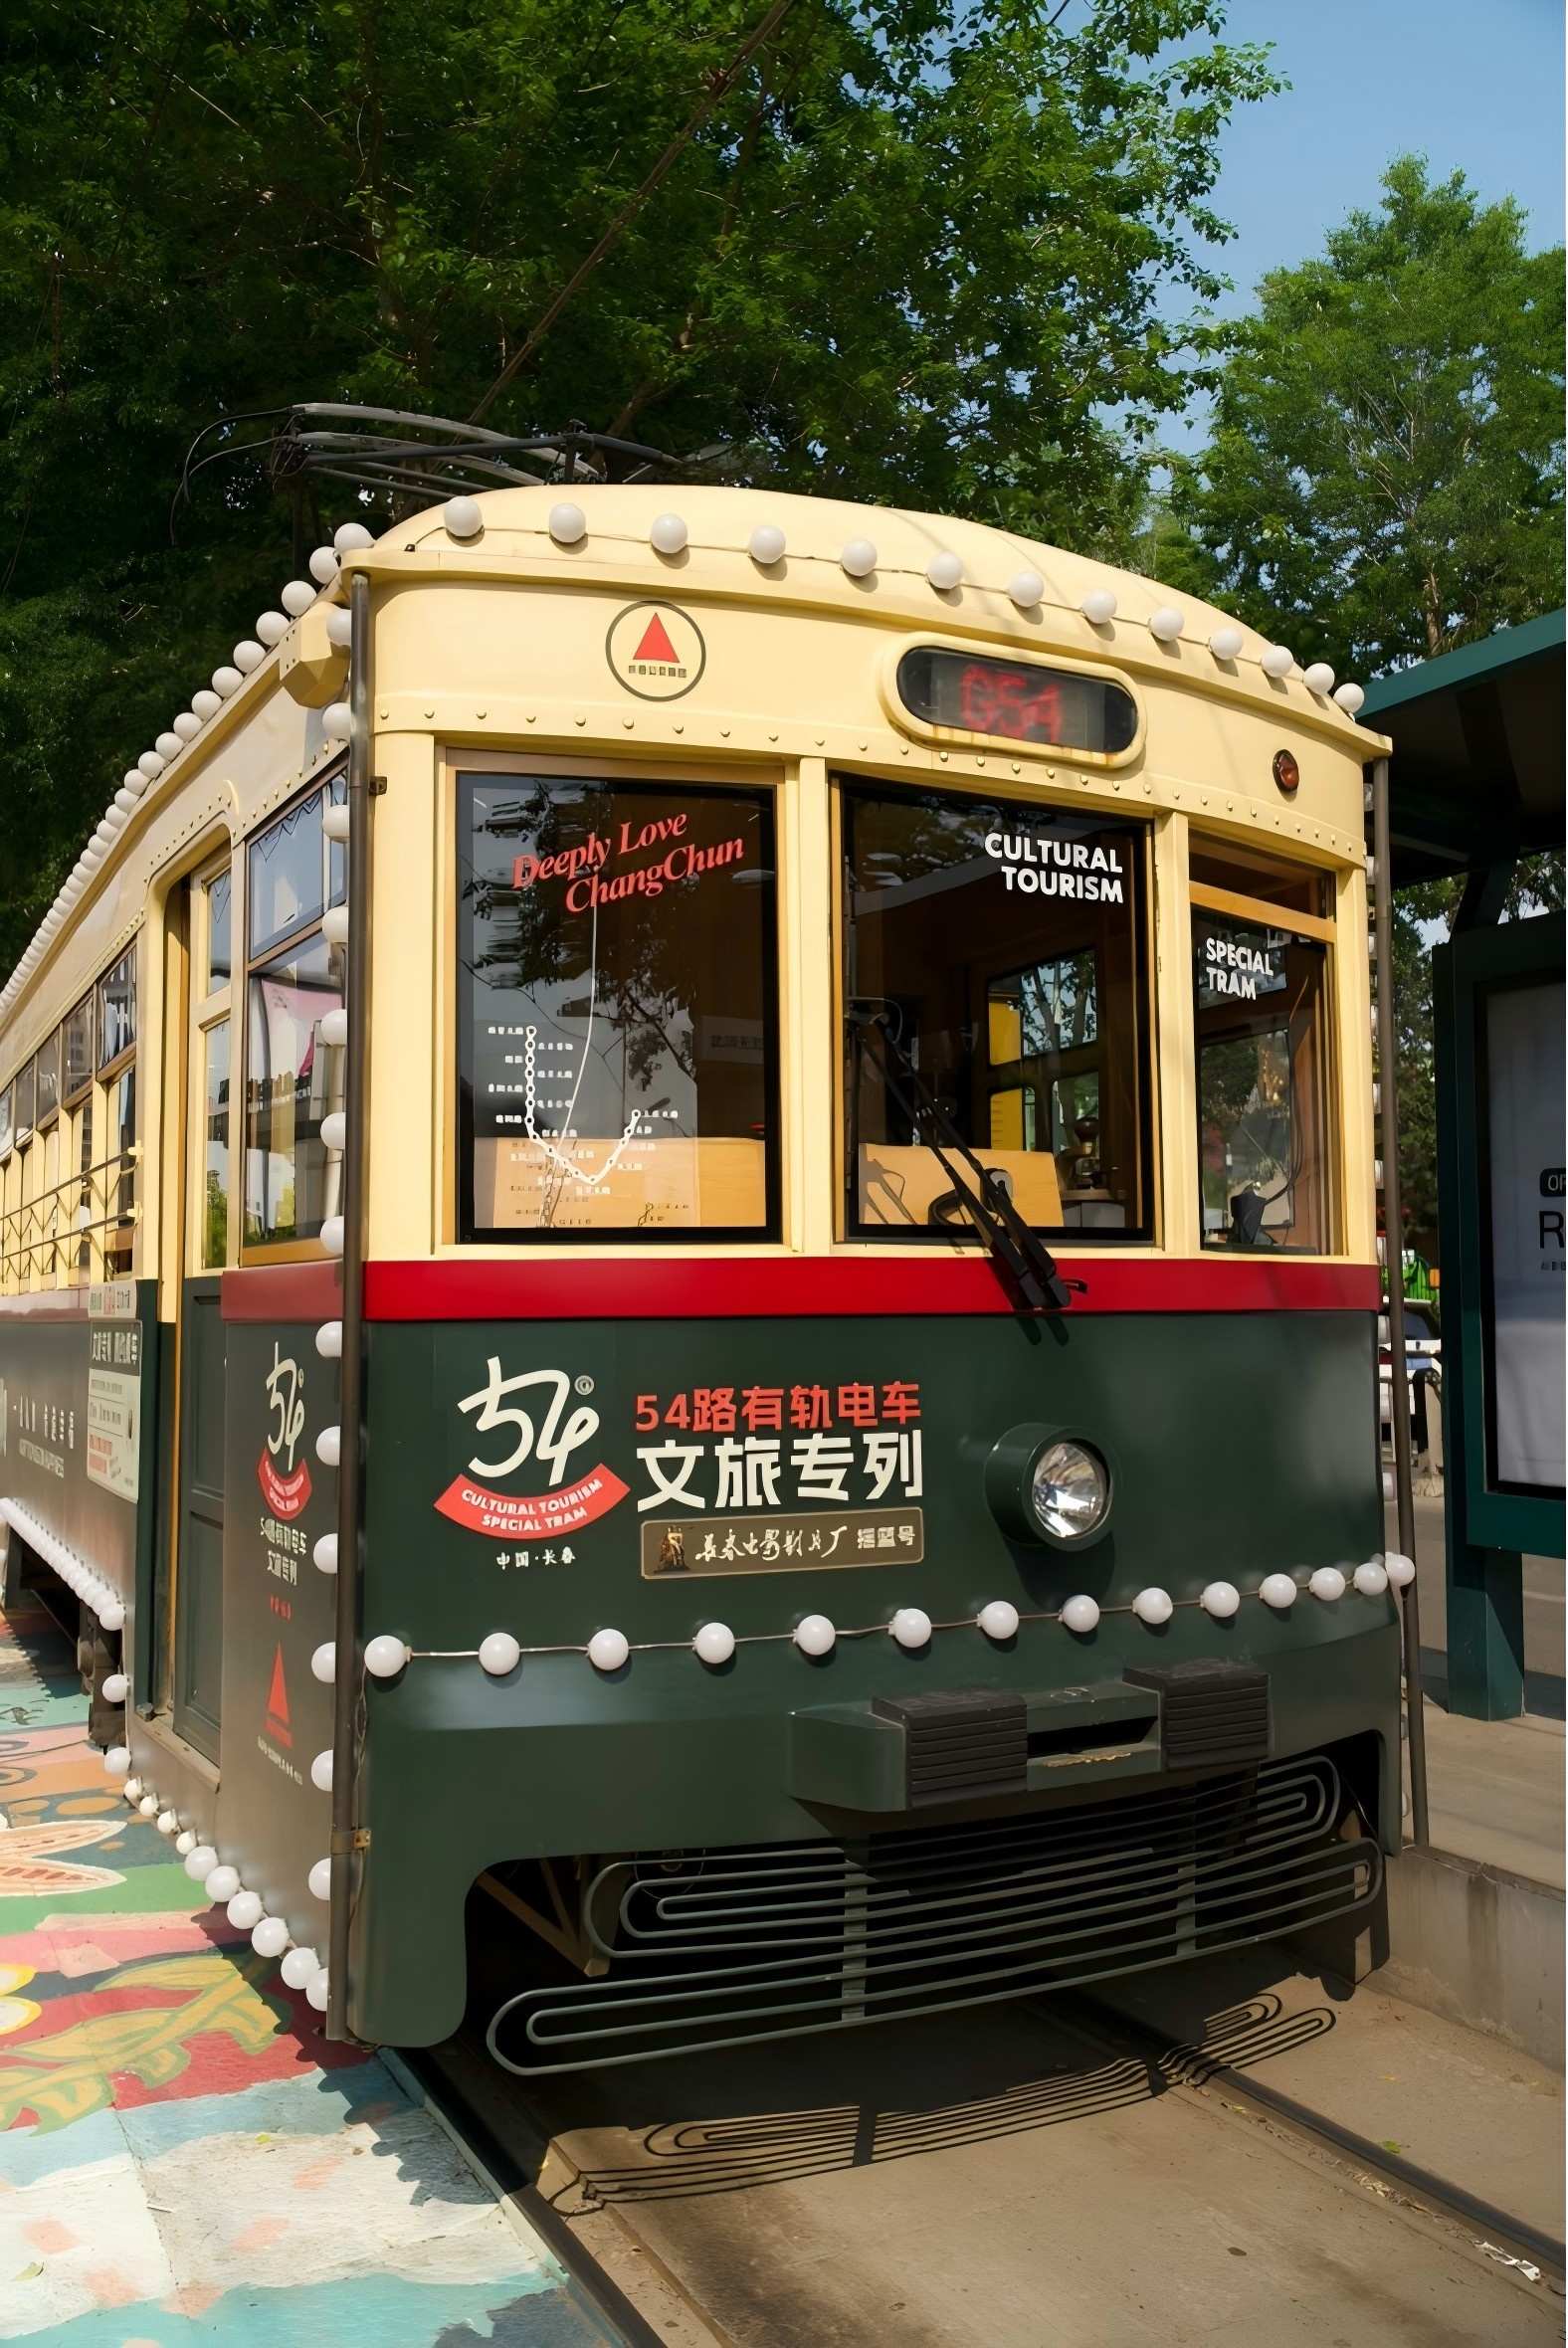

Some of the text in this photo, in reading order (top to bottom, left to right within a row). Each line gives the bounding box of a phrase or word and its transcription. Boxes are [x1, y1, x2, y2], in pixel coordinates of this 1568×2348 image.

[512, 813, 688, 889] Deeply Love
[984, 832, 1123, 874] CULTURAL
[565, 838, 744, 912] ChangChun
[1001, 866, 1124, 904] TOURISM
[1206, 937, 1274, 977] SPECIAL
[1206, 966, 1258, 1001] TRAM
[635, 1380, 921, 1433] 54路有轨电车
[636, 1429, 923, 1513] 文旅专列
[461, 1478, 604, 1515] CULTURAL TOURISM
[482, 1506, 588, 1531] SPECIAL TRAM
